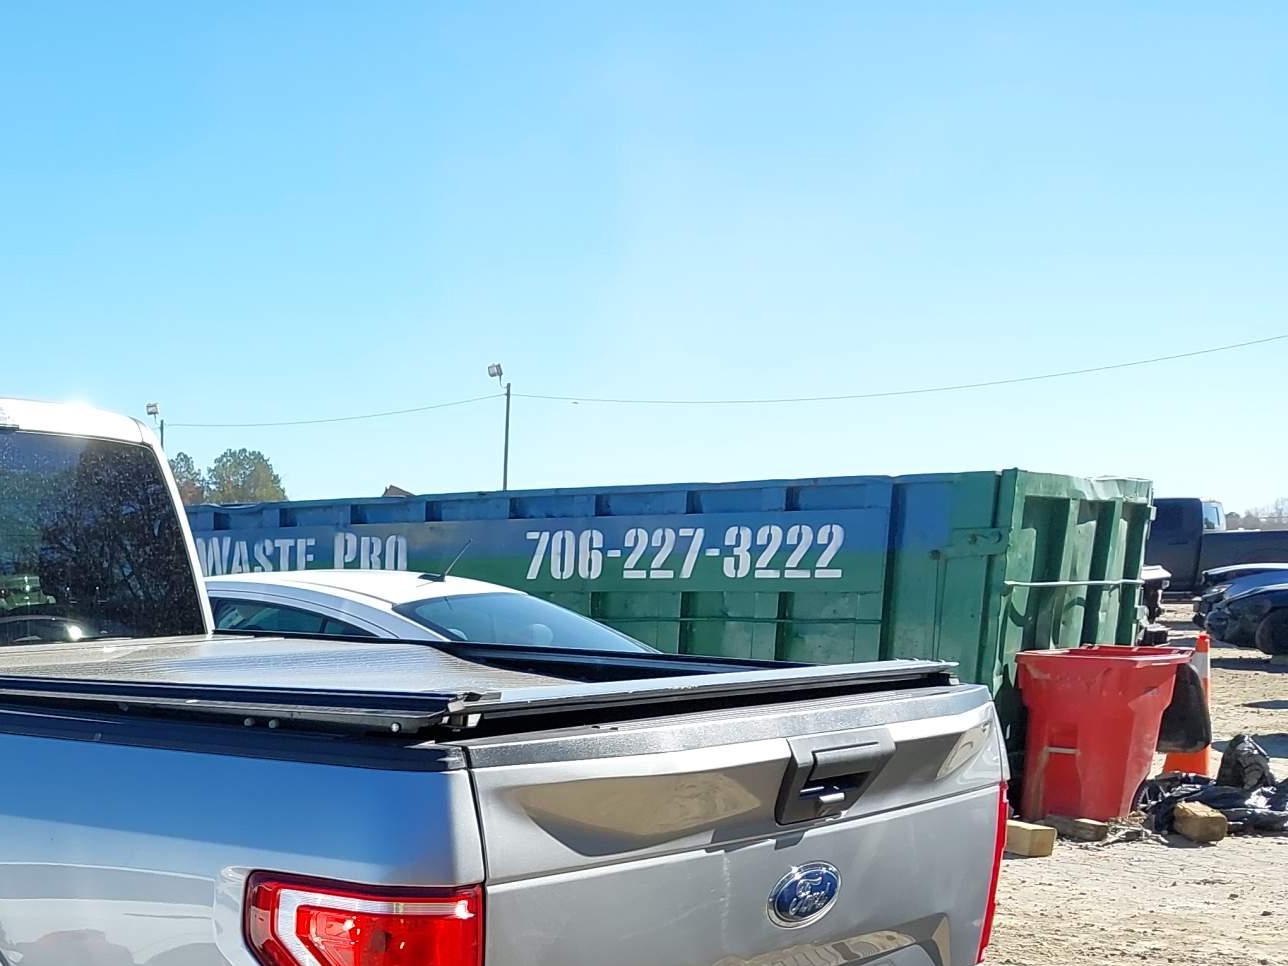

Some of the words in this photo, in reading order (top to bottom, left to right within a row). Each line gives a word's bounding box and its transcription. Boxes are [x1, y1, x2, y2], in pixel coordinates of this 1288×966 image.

[195, 535, 317, 577] WASTE
[333, 531, 409, 571] PRO
[525, 524, 846, 580] 706-227-3222
[788, 876, 831, 916] Ford
